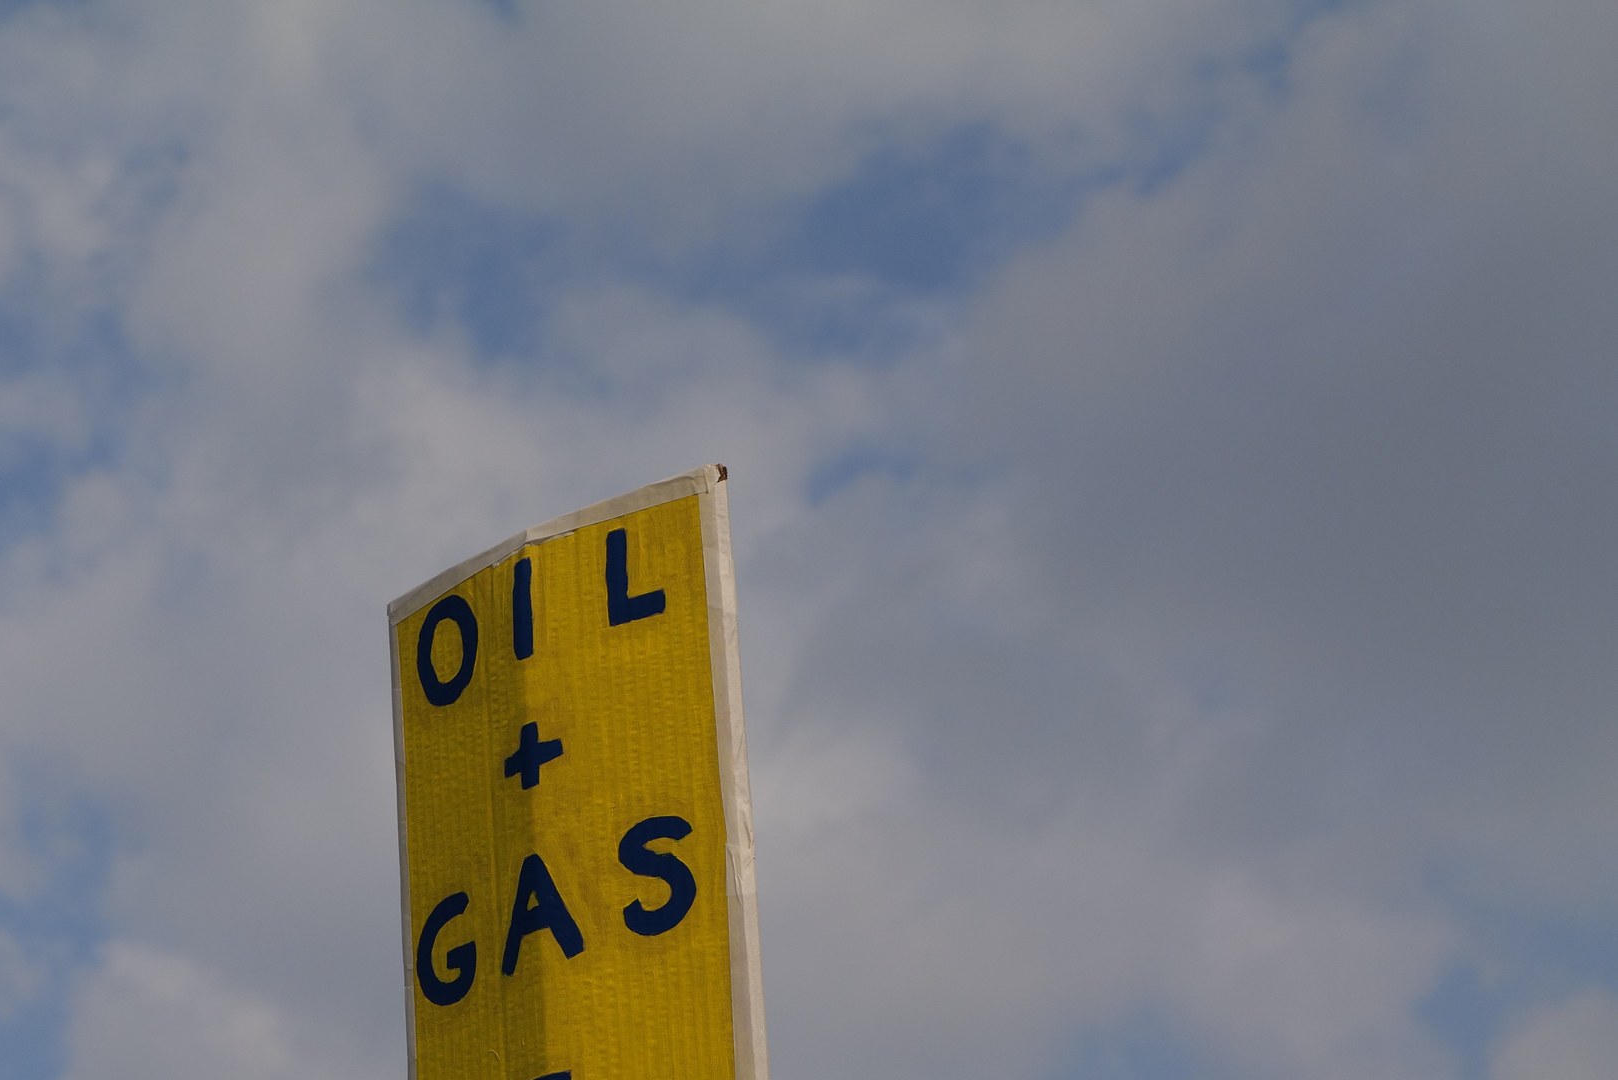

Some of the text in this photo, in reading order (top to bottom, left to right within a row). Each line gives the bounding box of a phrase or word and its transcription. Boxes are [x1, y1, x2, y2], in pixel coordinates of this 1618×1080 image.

[416, 528, 667, 707] OIL
[503, 721, 564, 790] +
[416, 816, 697, 1007] GAS
